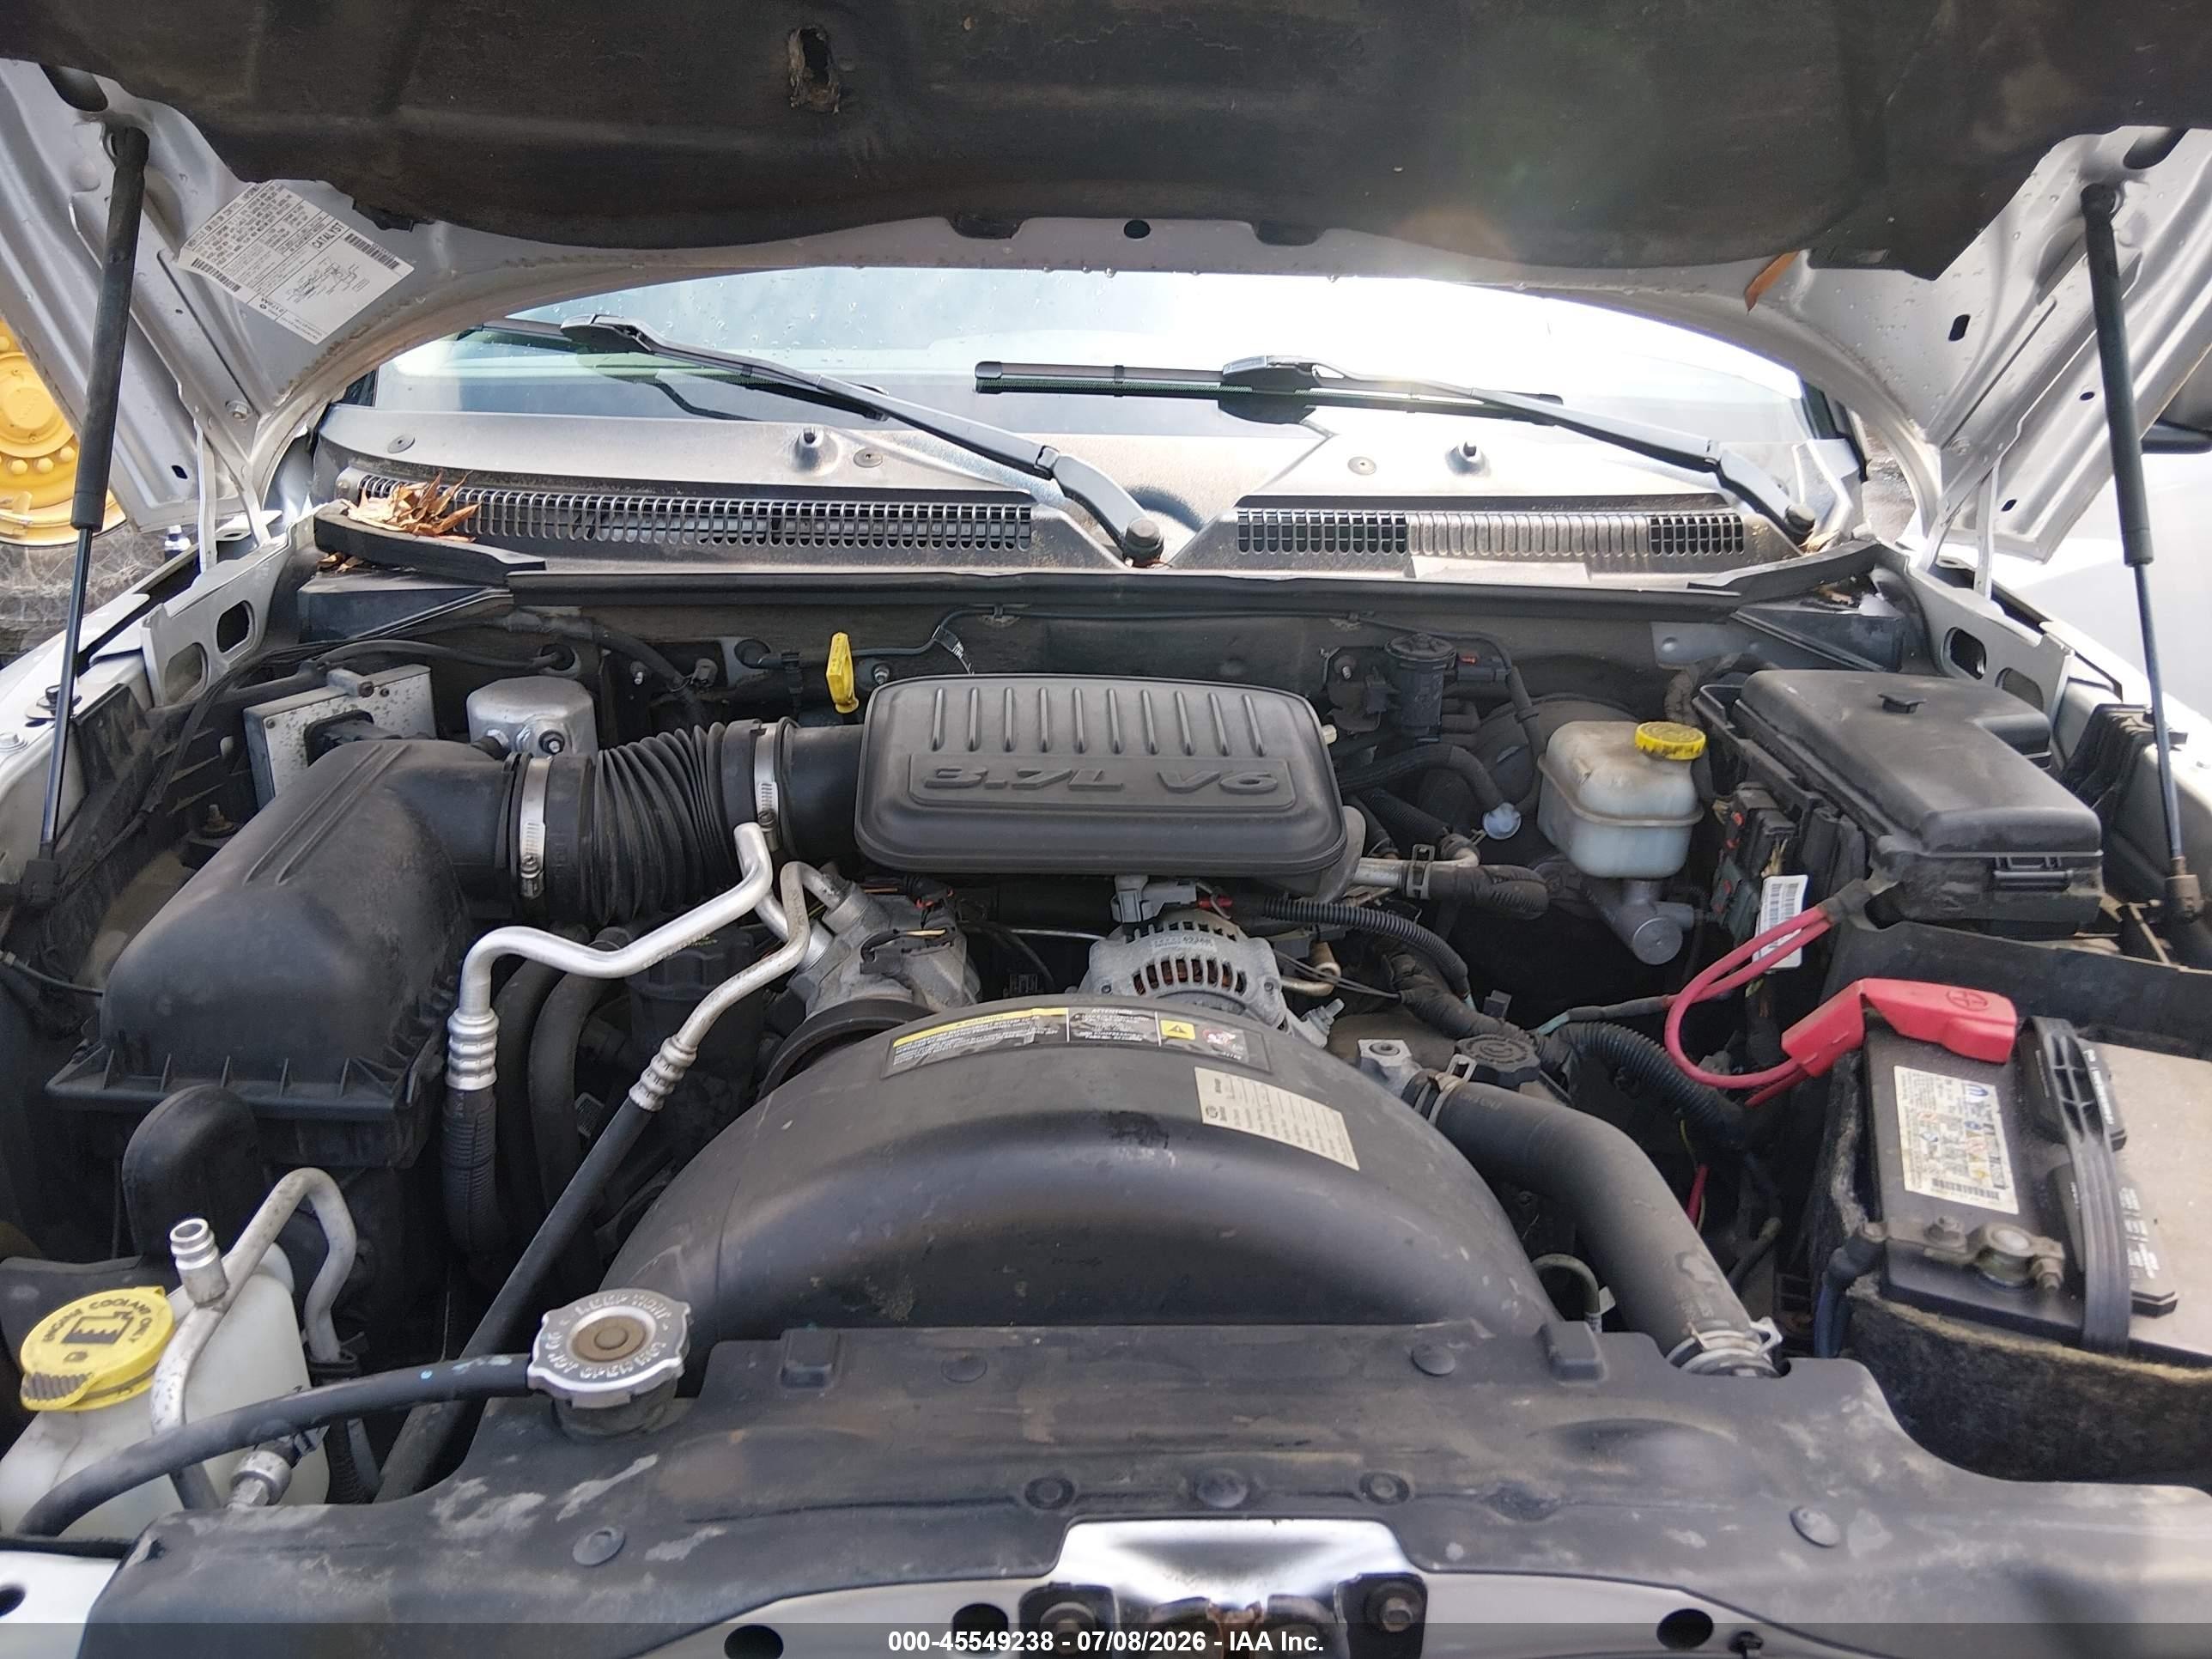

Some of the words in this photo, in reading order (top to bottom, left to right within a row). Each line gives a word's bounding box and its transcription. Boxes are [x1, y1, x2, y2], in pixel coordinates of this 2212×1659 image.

[312, 222, 343, 249] CATALYST
[923, 768, 1122, 792] 3.7L
[1157, 769, 1278, 794] V6
[43, 1308, 83, 1342] ENGINE
[88, 1297, 152, 1316] COOLANT
[129, 1316, 153, 1342] ONLY
